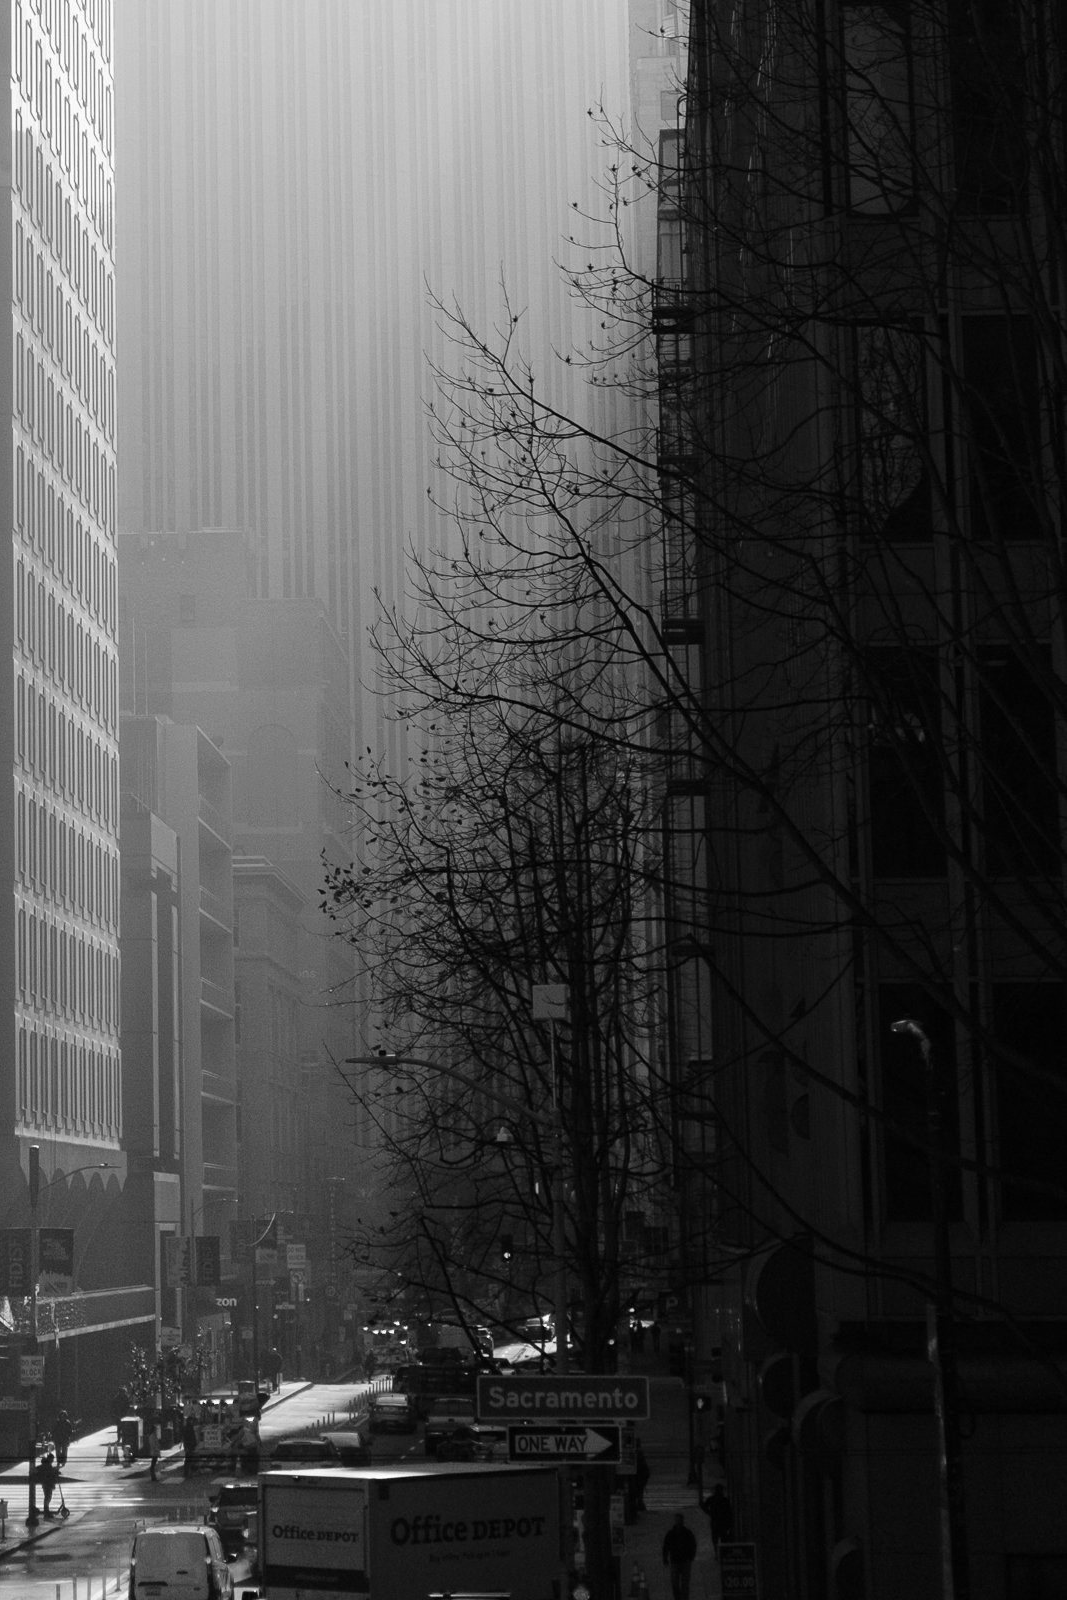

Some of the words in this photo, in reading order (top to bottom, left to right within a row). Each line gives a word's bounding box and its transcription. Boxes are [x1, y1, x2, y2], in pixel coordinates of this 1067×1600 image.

[665, 1296, 679, 1312] P
[488, 1387, 639, 1410] Sacramento
[517, 1436, 550, 1454] ONE
[554, 1435, 587, 1453] WAY
[272, 1525, 315, 1542] Office
[316, 1531, 359, 1543] DEPOT
[390, 1515, 468, 1546] Office
[472, 1516, 545, 1541] DEPOT
